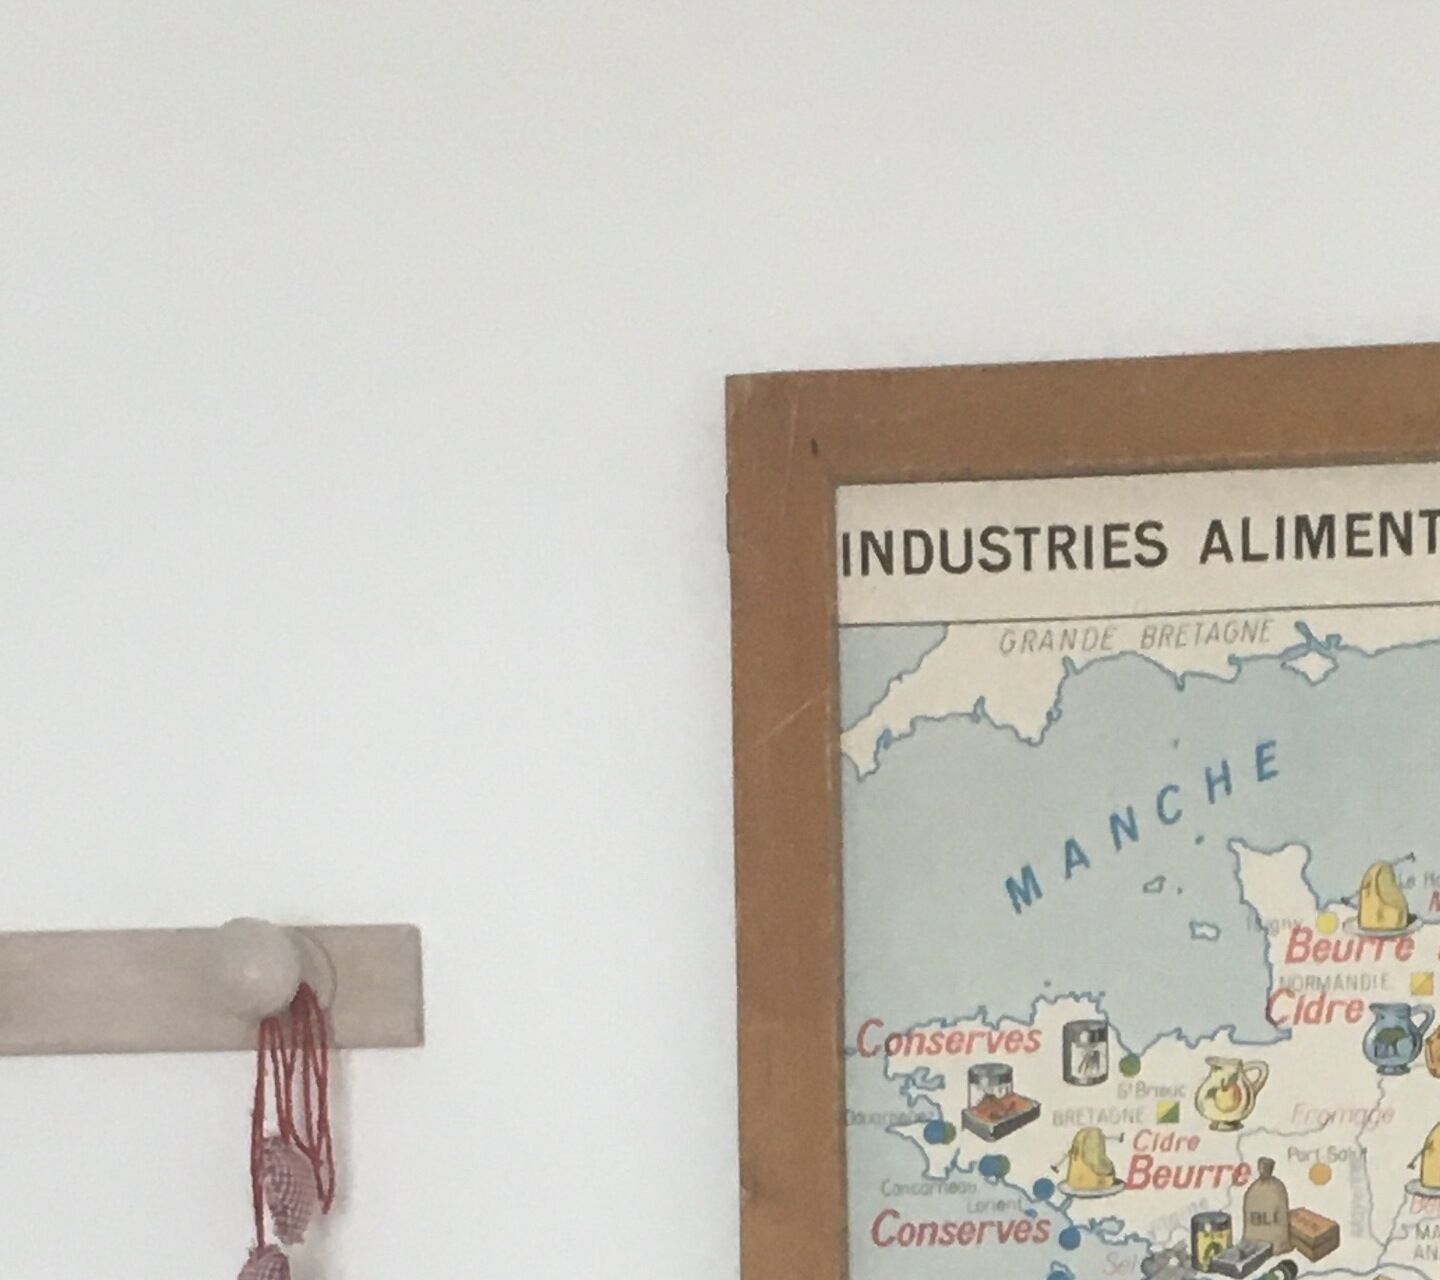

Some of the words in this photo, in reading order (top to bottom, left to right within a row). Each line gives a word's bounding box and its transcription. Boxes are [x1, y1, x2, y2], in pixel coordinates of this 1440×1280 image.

[841, 520, 1168, 578] INDUSTRIES
[999, 625, 1114, 655] GRANDE
[1140, 618, 1276, 650] BRETAGNE
[1003, 740, 1281, 915] MANCHE
[1285, 929, 1415, 964] Beurre
[1280, 973, 1390, 992] NORMANDIE
[1268, 989, 1365, 1025] Cidre
[857, 1018, 1042, 1057] Conserves
[1052, 1107, 1144, 1127] BRETAGNE
[1133, 1128, 1199, 1153] Cidre
[1126, 1154, 1251, 1190] Beurre
[871, 1208, 1051, 1247] Conserves
